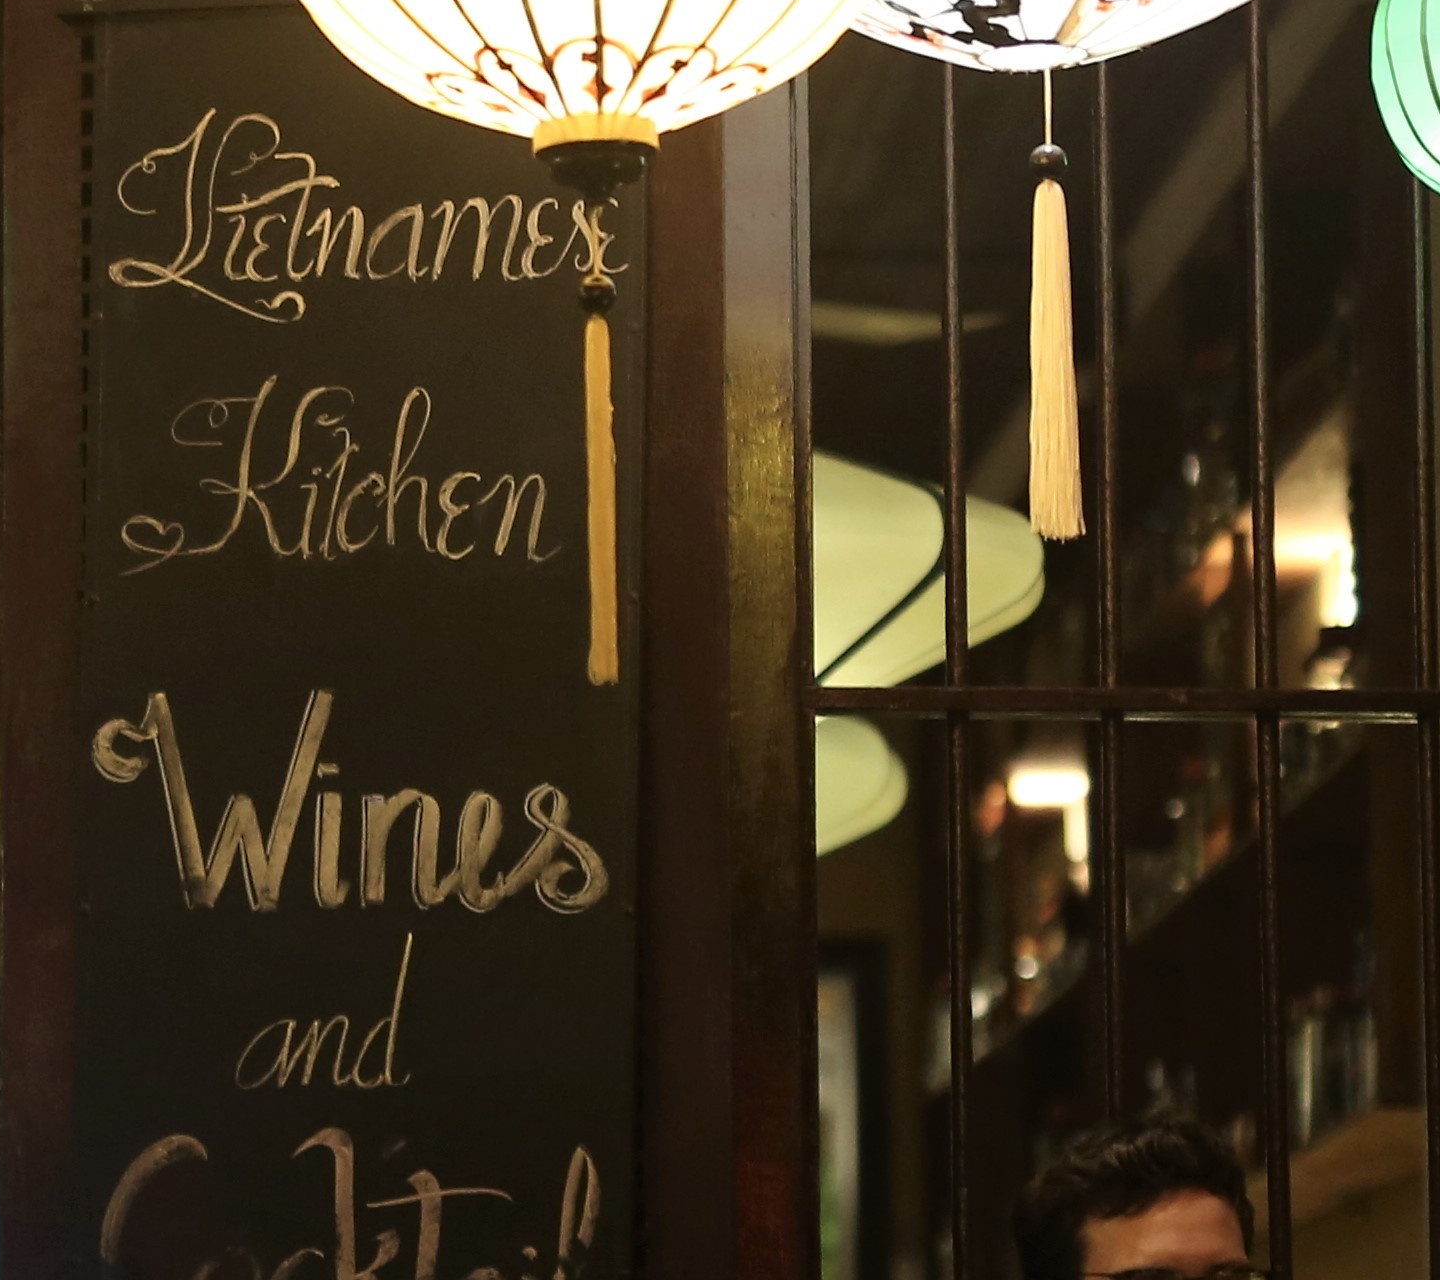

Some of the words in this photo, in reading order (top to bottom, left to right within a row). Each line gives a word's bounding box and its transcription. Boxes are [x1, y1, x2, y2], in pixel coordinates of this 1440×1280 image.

[121, 374, 562, 576] Kitchen
[92, 688, 612, 913] Wines
[233, 931, 413, 1090] and
